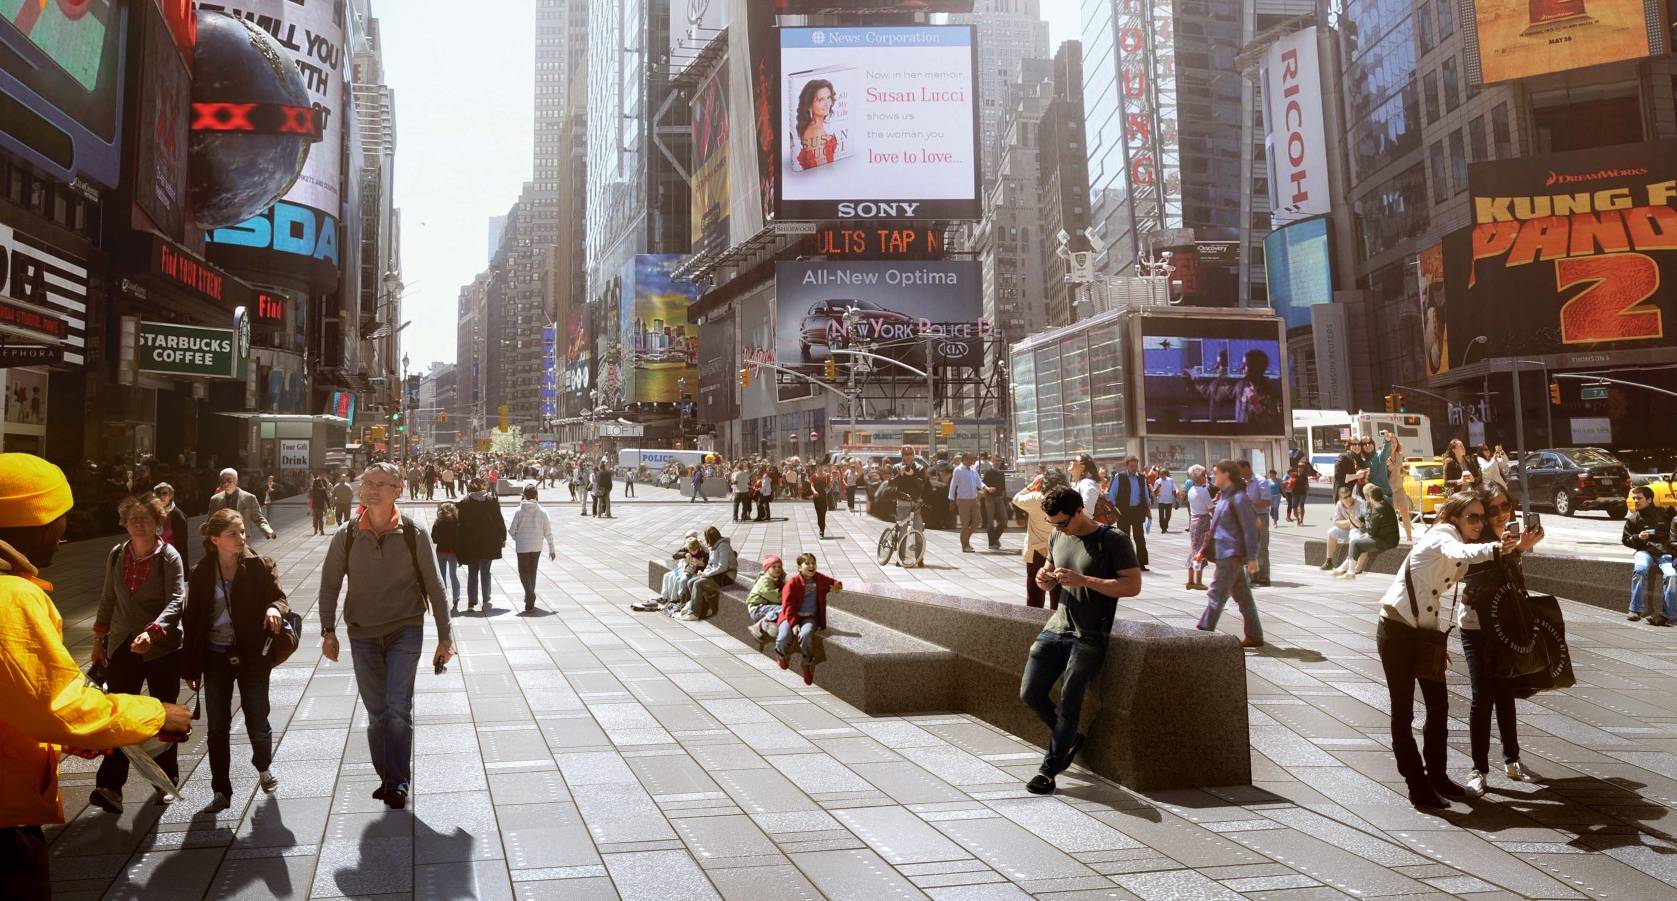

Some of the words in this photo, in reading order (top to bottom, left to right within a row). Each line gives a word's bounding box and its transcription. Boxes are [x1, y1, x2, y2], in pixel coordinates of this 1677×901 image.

[829, 32, 860, 43] News
[866, 31, 940, 45] Corporation
[305, 29, 338, 70] YOU
[893, 71, 901, 79] in
[904, 71, 922, 79] her
[866, 87, 915, 102] Susan
[921, 87, 964, 102] Lucci
[866, 112, 899, 120] shows
[1281, 47, 1308, 204] RICOH
[926, 131, 944, 141] you
[868, 148, 899, 164] love
[904, 151, 917, 163] to
[922, 148, 963, 163] love...
[838, 202, 919, 218] SONY
[1474, 187, 1632, 223] KUNG
[205, 201, 338, 266] SDA
[877, 230, 915, 254] TAP
[802, 269, 878, 285] All-New
[885, 269, 957, 287] Optima
[1554, 252, 1663, 345] 2
[259, 295, 281, 320] Find
[871, 317, 914, 338] YORK
[919, 317, 971, 338] POLICE
[139, 333, 231, 352] STARBUCKS
[153, 350, 213, 365] COFFEE
[605, 427, 637, 435] LOFT
[282, 455, 307, 465] Drink
